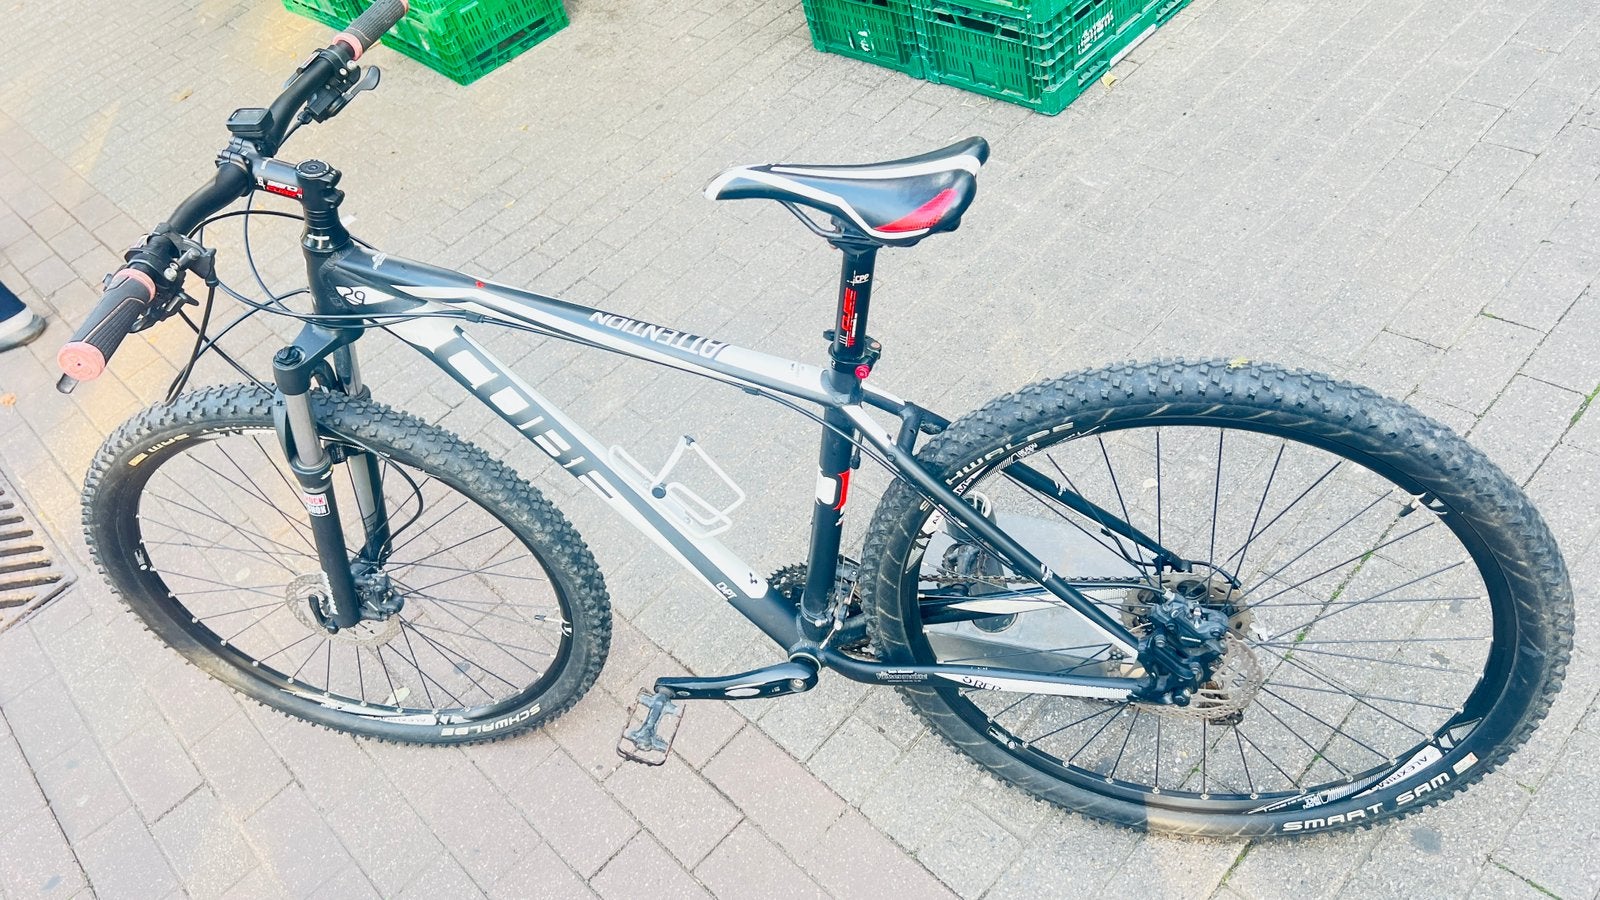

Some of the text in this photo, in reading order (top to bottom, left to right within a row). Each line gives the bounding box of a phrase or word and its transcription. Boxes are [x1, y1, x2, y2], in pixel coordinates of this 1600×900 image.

[341, 286, 366, 305] 29
[588, 311, 725, 359] ATTENTION
[440, 703, 542, 737] SCHWALBE
[1283, 771, 1451, 832] SMART SAM
